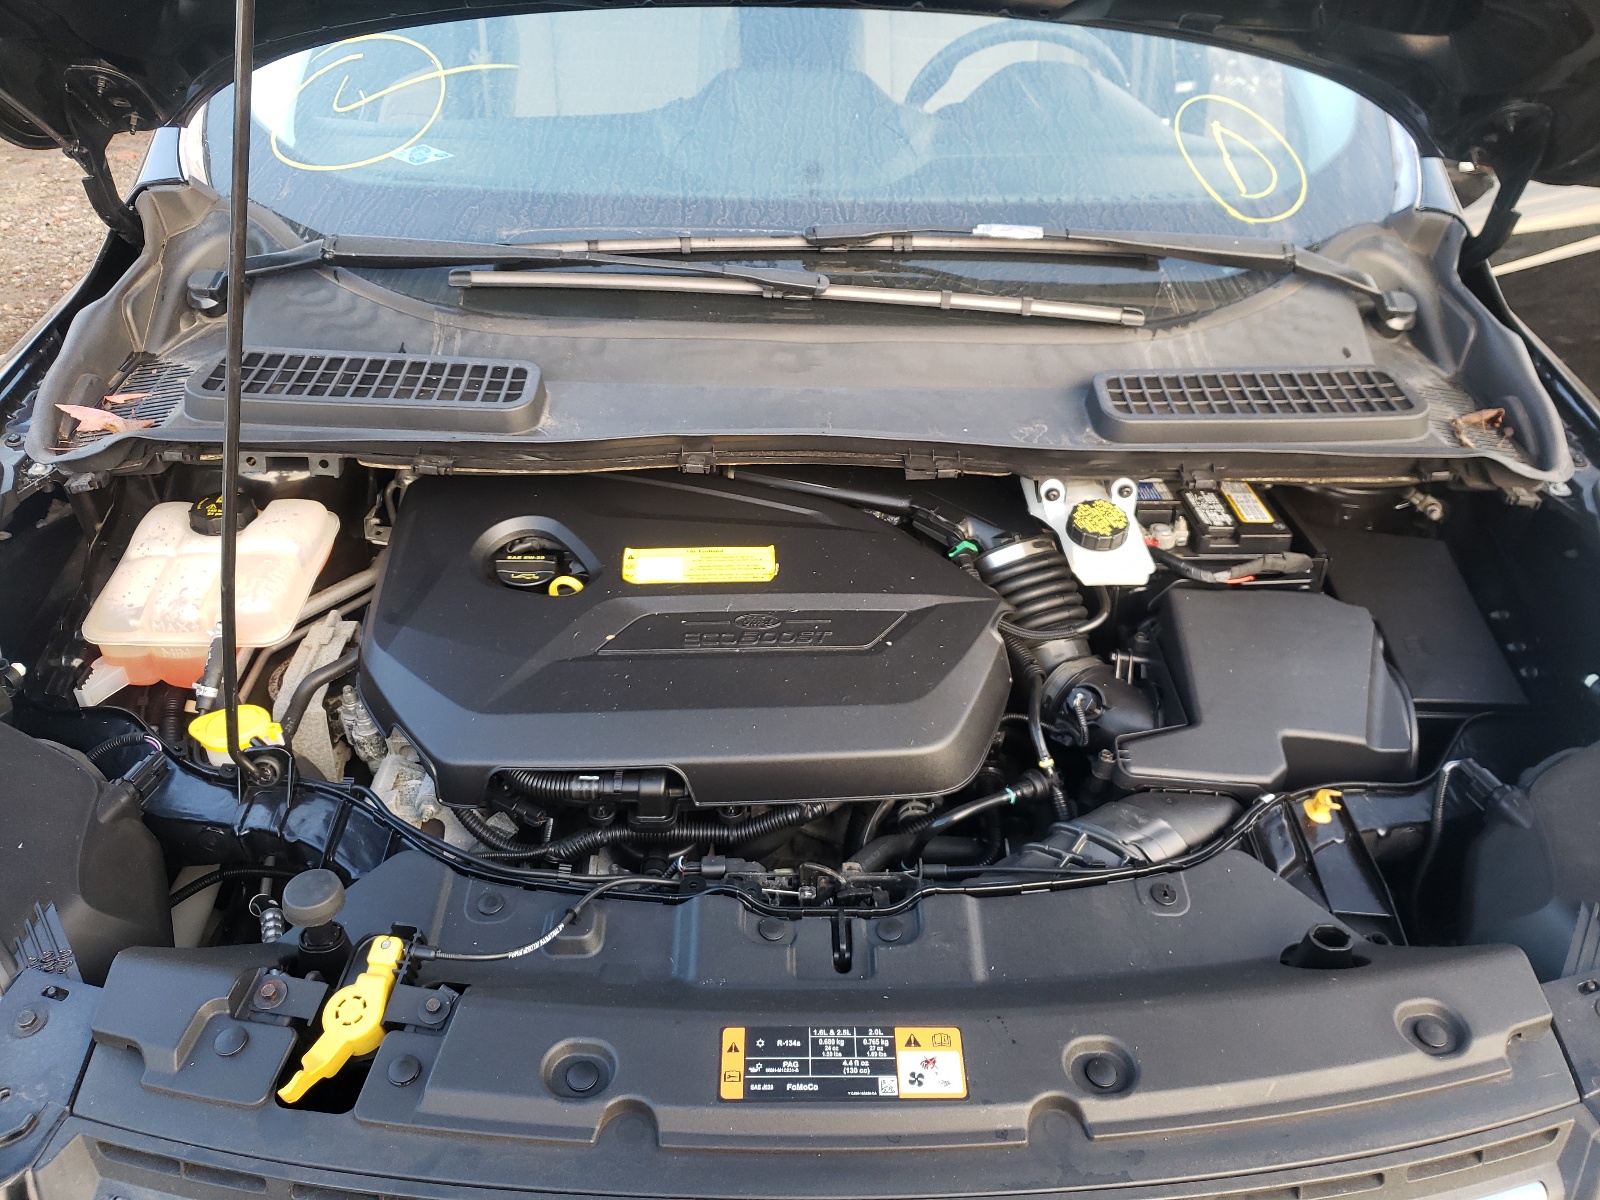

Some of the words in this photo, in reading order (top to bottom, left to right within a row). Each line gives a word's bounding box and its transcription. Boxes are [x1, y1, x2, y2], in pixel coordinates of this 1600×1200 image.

[161, 647, 191, 659] MIN
[813, 1028, 828, 1036] 1.6L
[829, 1028, 835, 1036] &
[868, 1028, 884, 1036] 2.0L
[776, 1039, 801, 1047] R-134a
[836, 1038, 845, 1047] kg
[863, 1038, 880, 1046] 0.765
[880, 1038, 889, 1047] kg
[843, 1067, 858, 1075] (130
[859, 1067, 871, 1075] cc)
[786, 1083, 819, 1091] FoMoCo
